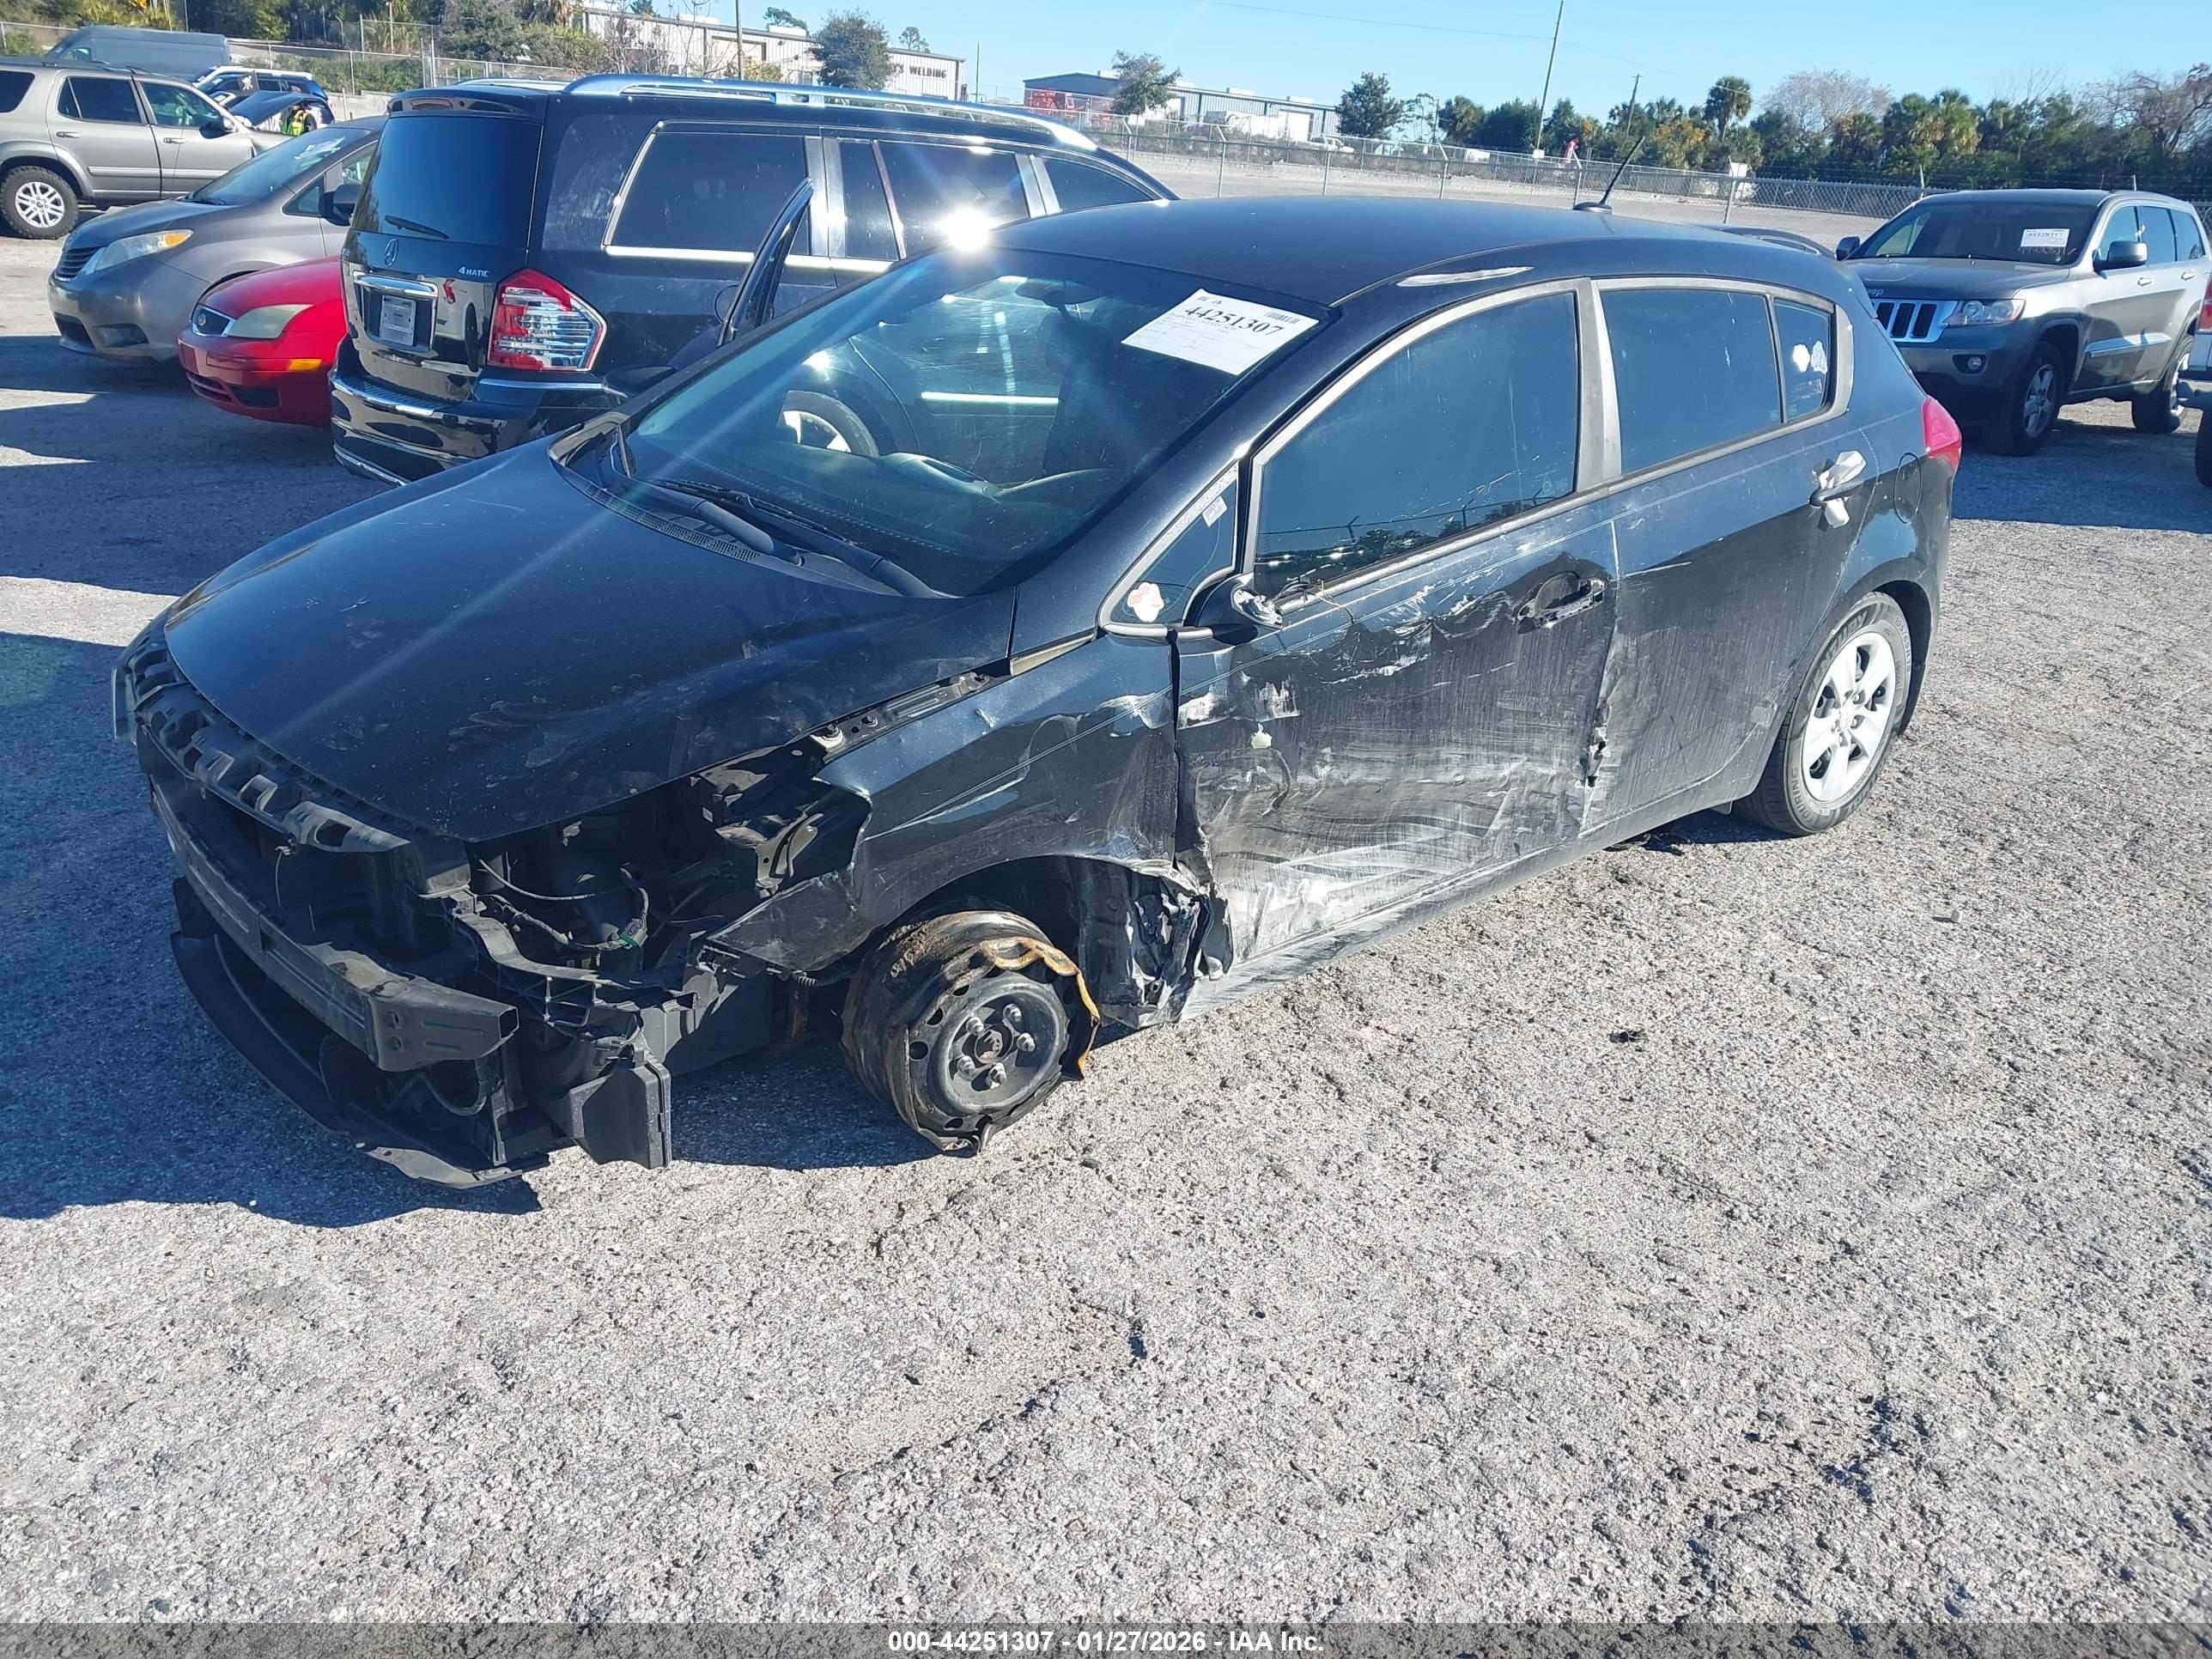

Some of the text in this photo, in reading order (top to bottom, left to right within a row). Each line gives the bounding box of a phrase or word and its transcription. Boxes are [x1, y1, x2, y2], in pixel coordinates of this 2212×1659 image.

[909, 65, 946, 78] WELDING
[458, 265, 489, 277] 4MATIC
[1184, 306, 1285, 336] 44251307
[1791, 767, 1814, 823] TOURING
